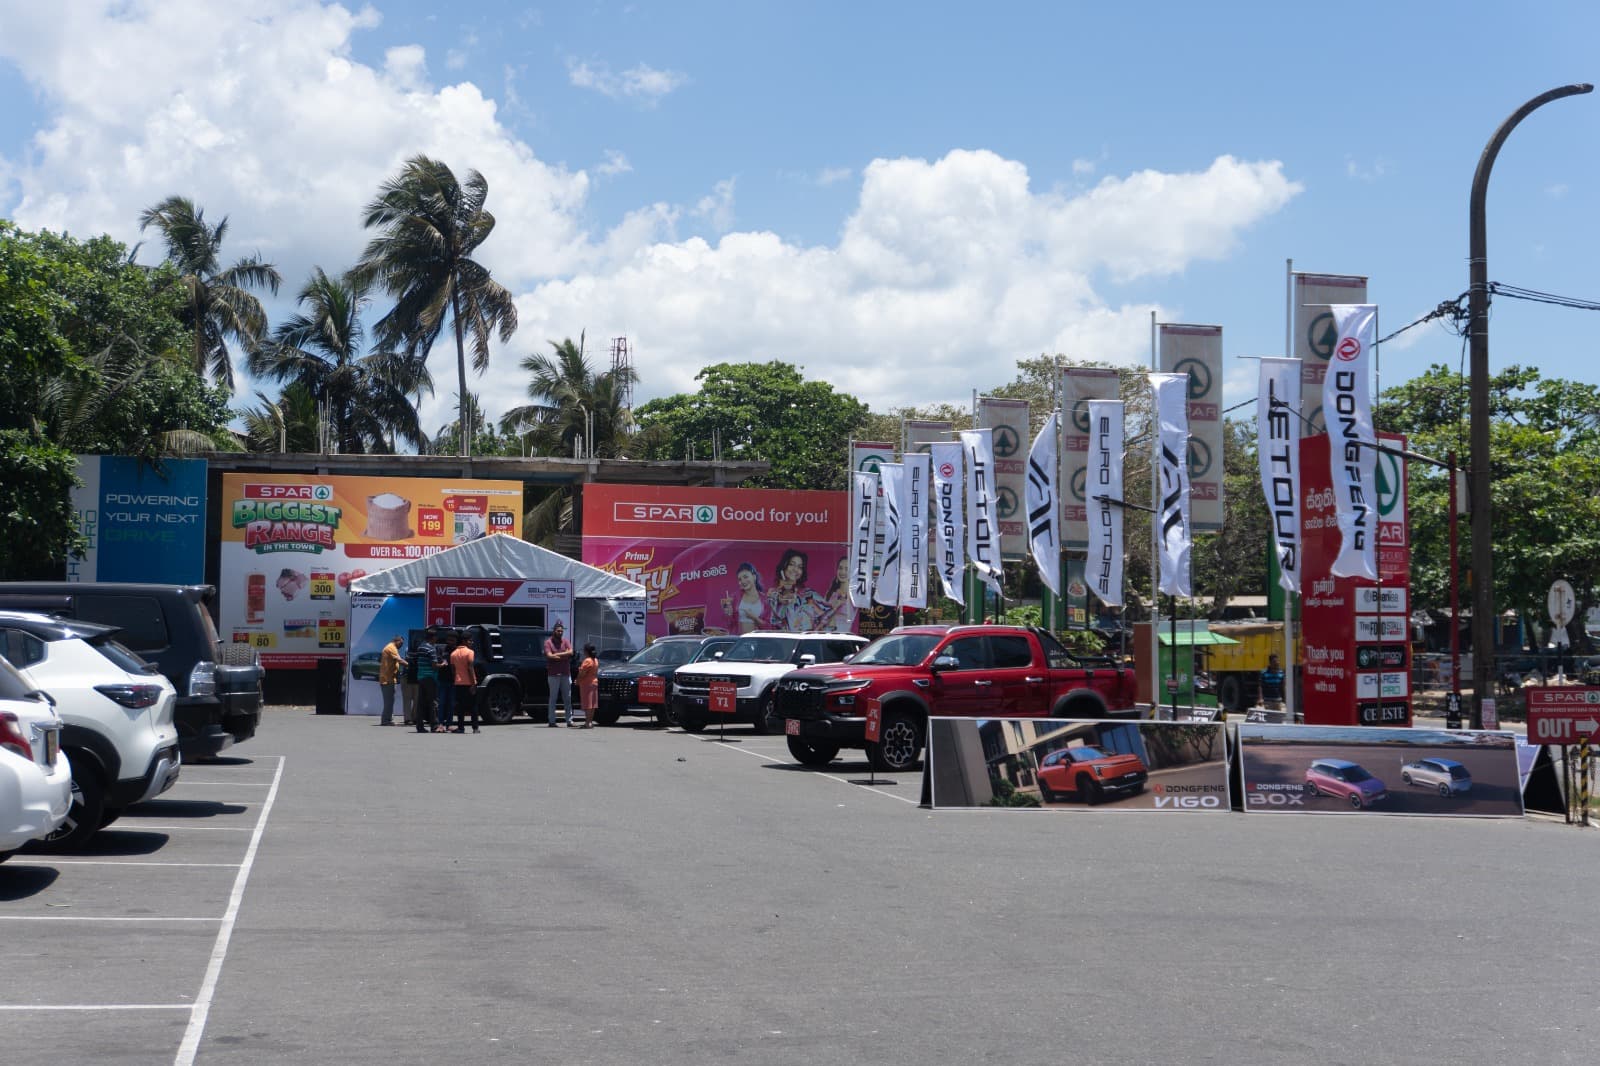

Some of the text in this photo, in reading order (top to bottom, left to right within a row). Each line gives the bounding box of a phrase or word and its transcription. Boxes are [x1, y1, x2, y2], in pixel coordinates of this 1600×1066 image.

[1190, 406, 1218, 418] AR
[1335, 370, 1367, 550] DONGFENG
[1268, 378, 1298, 572] JETOUR
[260, 487, 311, 498] SPAR
[1191, 484, 1218, 497] AR
[105, 493, 199, 507] POWERING
[1099, 416, 1113, 596] EURO MOTORS
[105, 512, 199, 523] YOUR NEXT
[233, 500, 342, 527] BIGGEST
[633, 507, 828, 526] SPAR Good for you!
[422, 520, 441, 531] 199
[492, 516, 512, 525] 1100
[105, 529, 176, 542] DRIVE
[246, 520, 335, 546] RANGE
[910, 466, 921, 598] EURO MOTORS
[856, 482, 873, 596] JETOUR
[291, 543, 315, 551] TOWN
[371, 547, 390, 557] OVER
[624, 551, 650, 561] Prima
[680, 570, 700, 582] FUN
[314, 585, 331, 593] 300
[435, 586, 505, 597] WELCOME
[618, 611, 645, 626] T2
[1370, 621, 1386, 636] FOD
[256, 637, 270, 647] 80
[322, 631, 341, 641] 110
[1306, 645, 1345, 663] Thank you
[1307, 664, 1344, 680] for shopping
[1315, 681, 1337, 692] with us
[1544, 693, 1584, 702] SPAR
[1363, 707, 1405, 721] CEESTE
[1538, 718, 1572, 738] OUT
[1166, 784, 1225, 793] DONGFENG
[1256, 783, 1304, 791] DONGFENG
[1154, 795, 1219, 808] VIGO
[1249, 793, 1305, 805] BOX
